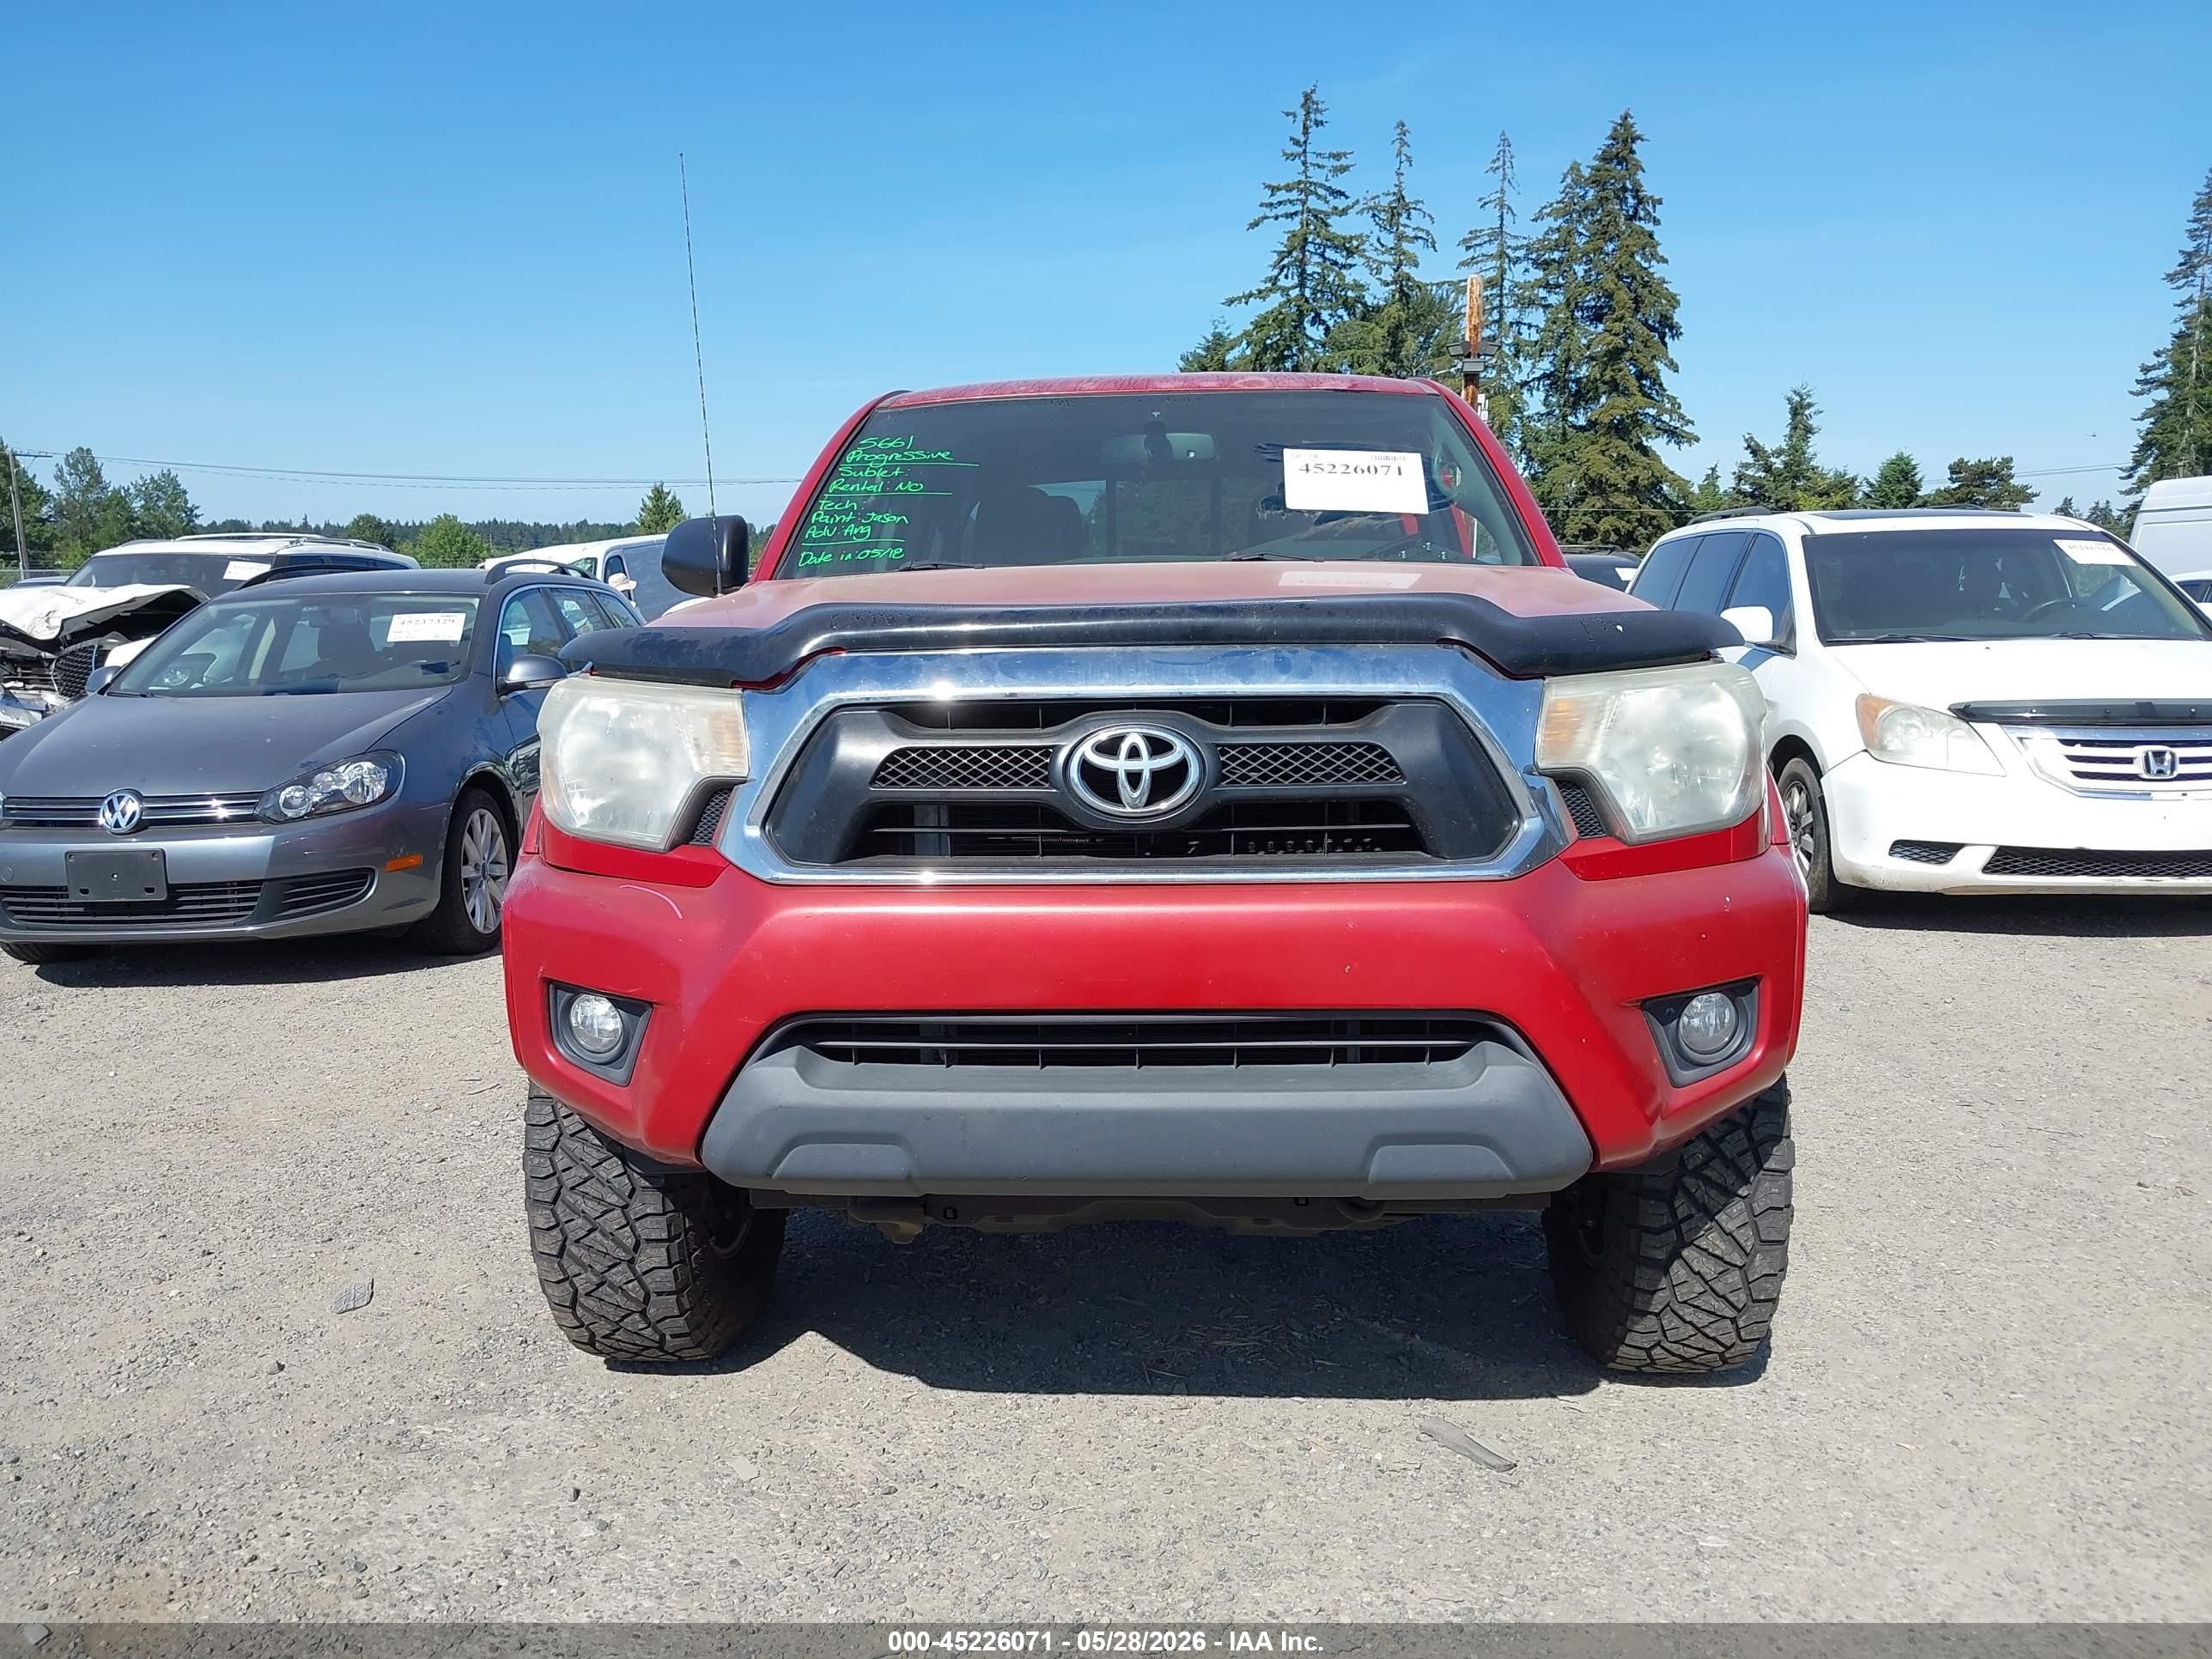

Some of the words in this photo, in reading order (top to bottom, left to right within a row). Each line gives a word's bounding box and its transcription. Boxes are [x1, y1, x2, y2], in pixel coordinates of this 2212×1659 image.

[857, 435, 915, 450] 5661
[846, 450, 955, 468] Progressive
[1298, 463, 1402, 477] 45226071
[798, 550, 833, 567] Date
